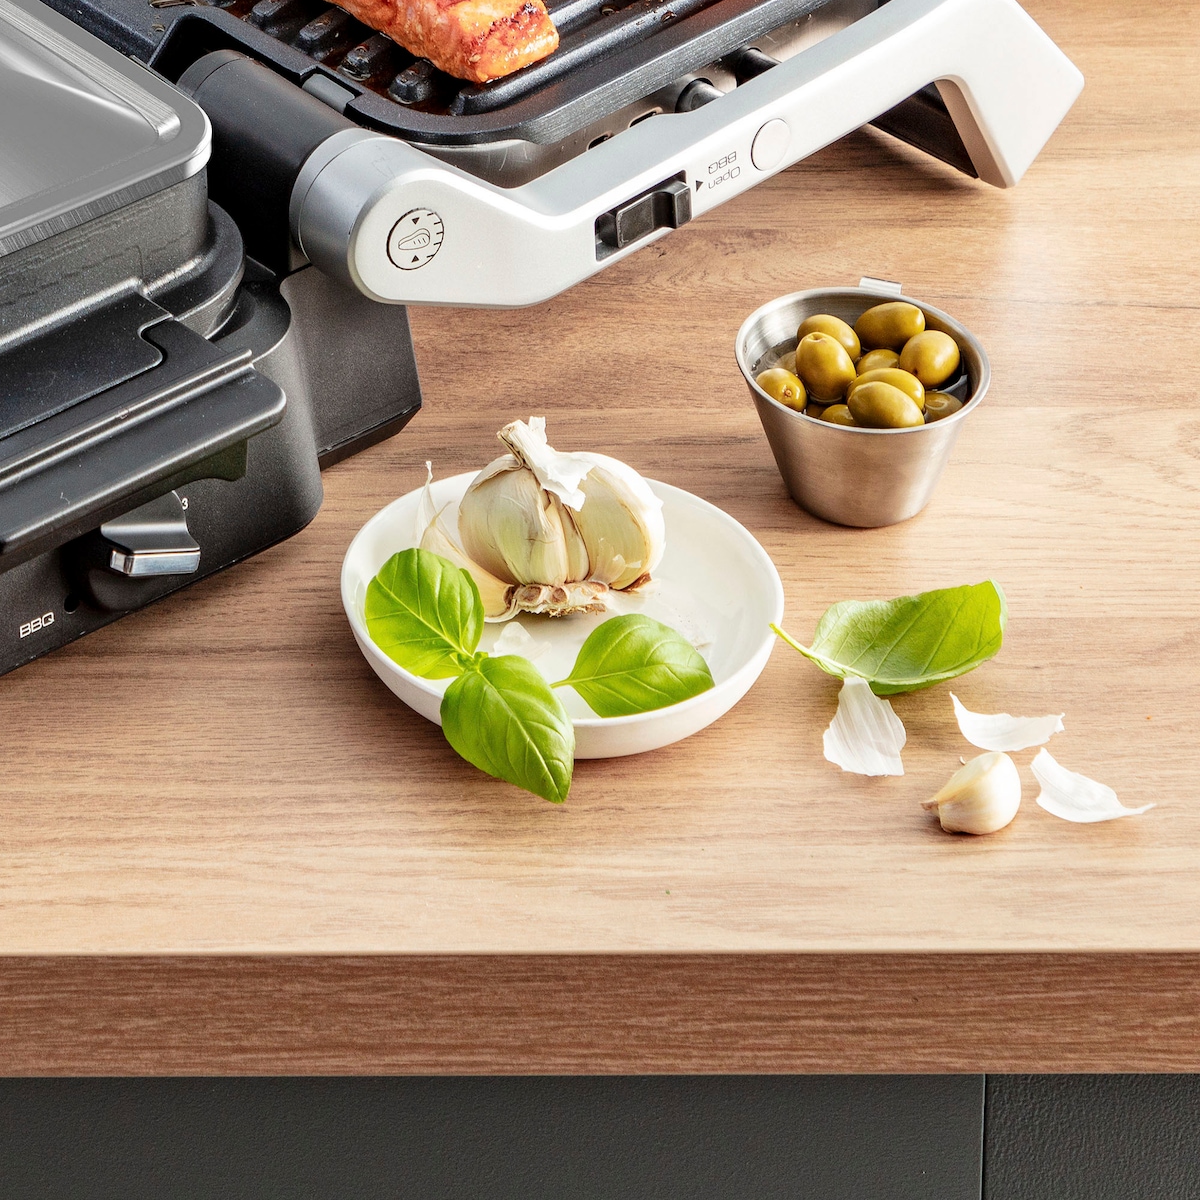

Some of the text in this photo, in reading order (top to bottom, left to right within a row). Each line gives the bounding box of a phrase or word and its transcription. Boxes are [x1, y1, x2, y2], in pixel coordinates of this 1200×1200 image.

[708, 151, 737, 175] BBQ
[708, 166, 741, 189] Open
[181, 497, 188, 510] 3
[19, 611, 55, 638] BBQ
